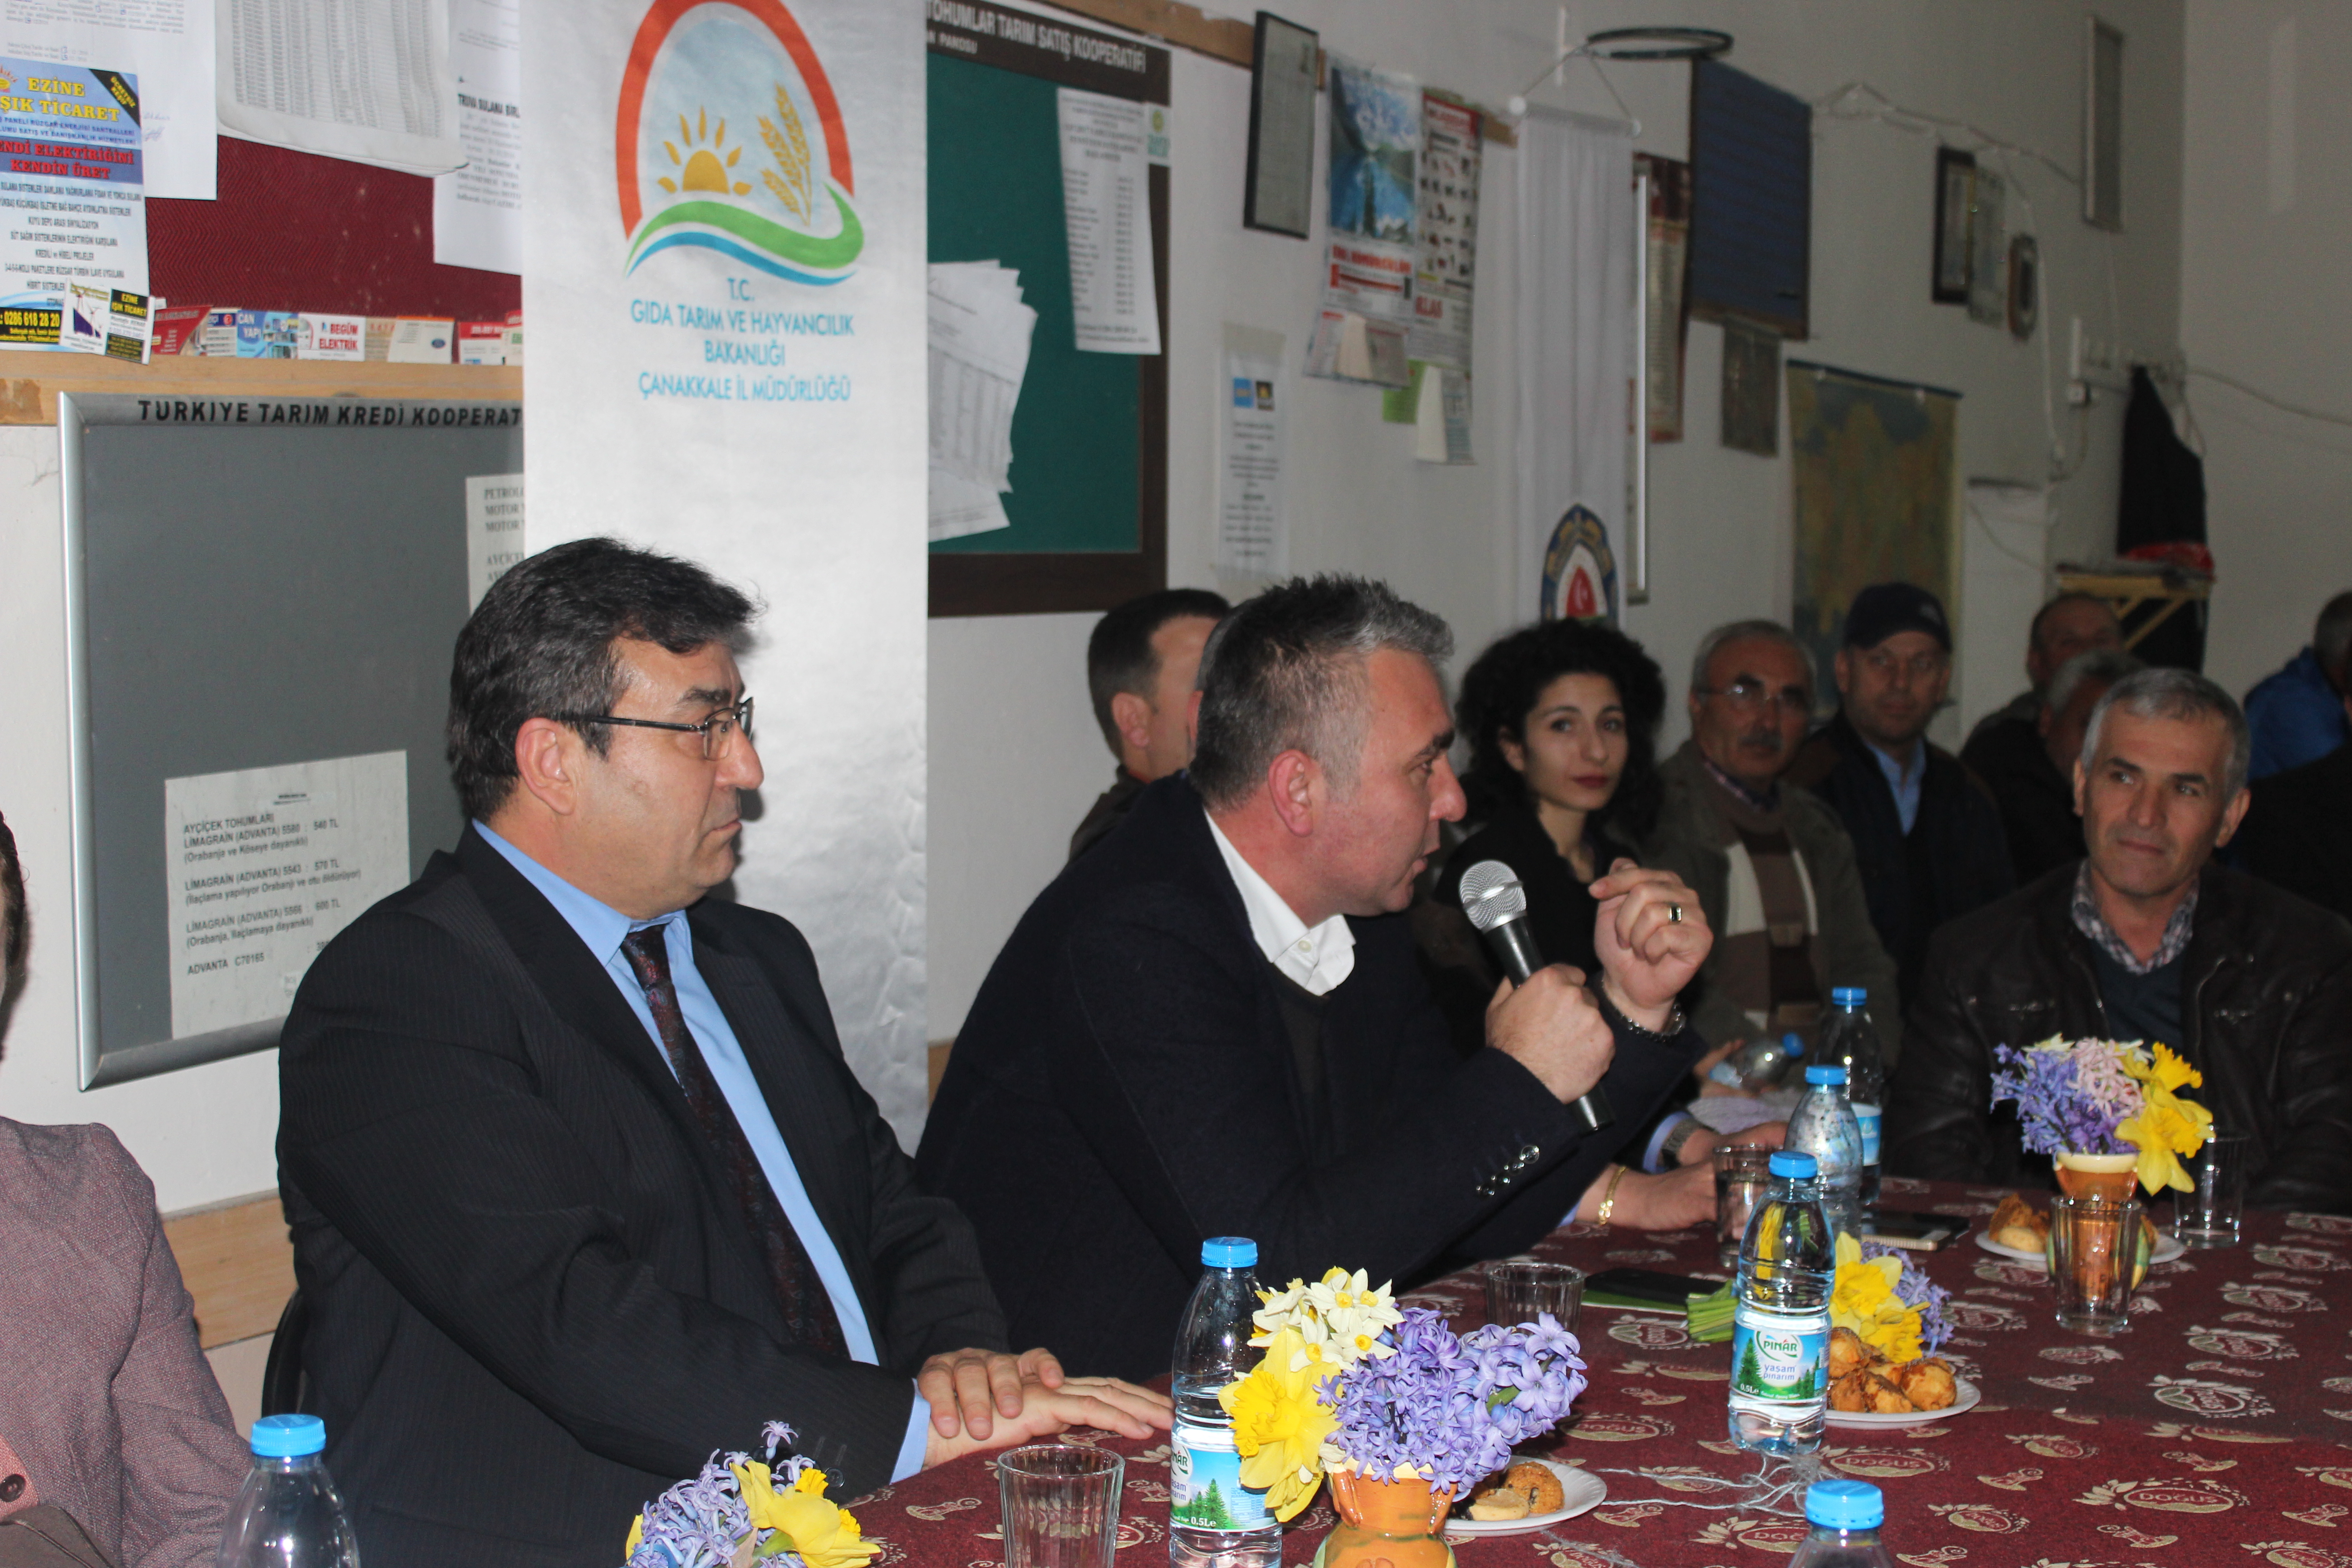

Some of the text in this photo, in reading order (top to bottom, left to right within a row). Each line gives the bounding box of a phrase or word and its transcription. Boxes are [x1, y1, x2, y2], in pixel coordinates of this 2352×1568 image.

[1038, 25, 1071, 61] SATIŞ
[28, 77, 85, 97] EZİNE
[39, 98, 121, 122] TİCARET
[34, 143, 134, 164] ELEKTİRİĞİNİ
[10, 159, 110, 179] KENDİN ÜRET
[727, 277, 755, 302] T.C.
[23, 311, 39, 326] 618
[50, 313, 60, 328] 20
[630, 299, 855, 337] GIDA TARIM VE HAYVANCILIK
[704, 339, 786, 366] BAKANLIĞI
[638, 371, 851, 401] ÇANAKKALE İL MÜDÜRLÜĞÜ
[258, 403, 330, 425] TARIM
[337, 402, 405, 426] KREDİ
[329, 818, 338, 829] TL
[330, 859, 340, 869] TL
[331, 899, 341, 909] TL
[187, 960, 229, 976] ADVANTA
[1763, 1339, 1798, 1352] PINAR
[1764, 1363, 1796, 1373] yaşam
